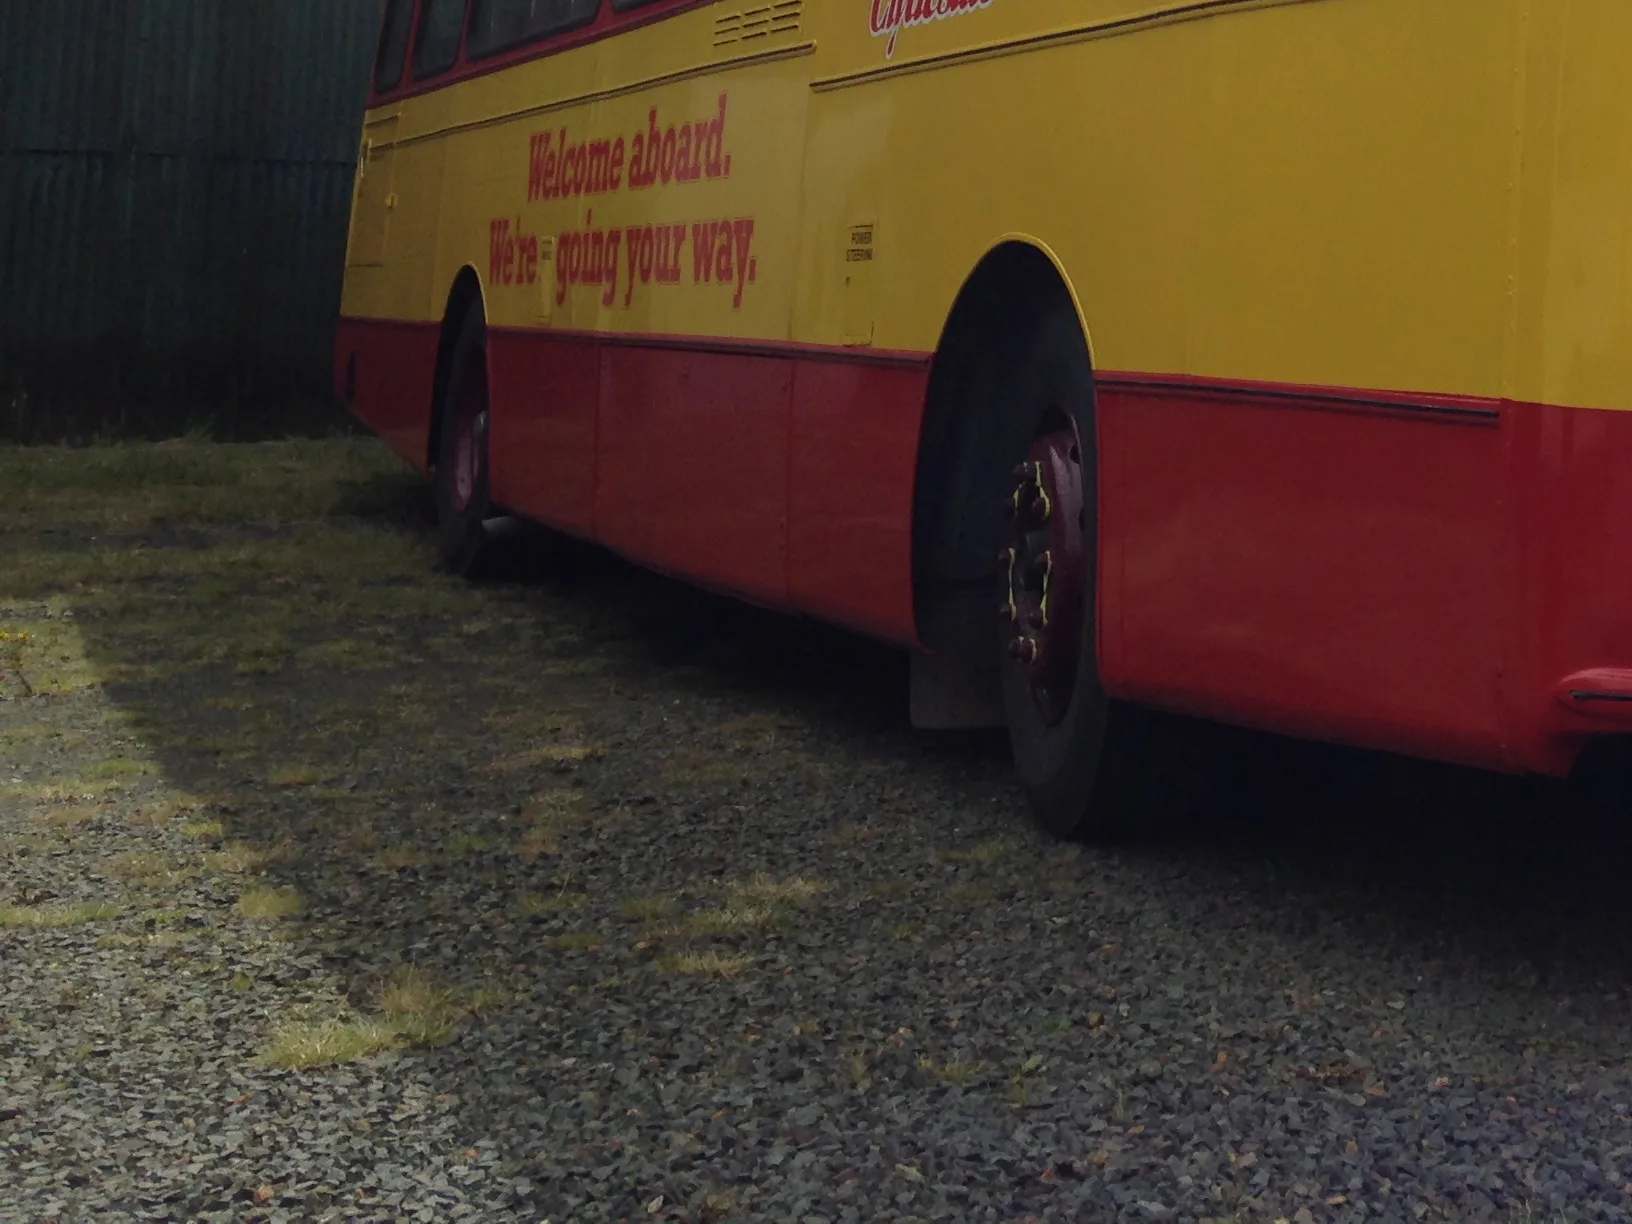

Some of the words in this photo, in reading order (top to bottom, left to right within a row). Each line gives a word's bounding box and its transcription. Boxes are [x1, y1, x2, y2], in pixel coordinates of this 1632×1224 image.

[528, 126, 624, 202] Welcome
[627, 91, 732, 191] aboard.
[489, 216, 537, 286] We're
[555, 209, 621, 307] going
[624, 221, 686, 308] your
[692, 216, 757, 309] way.
